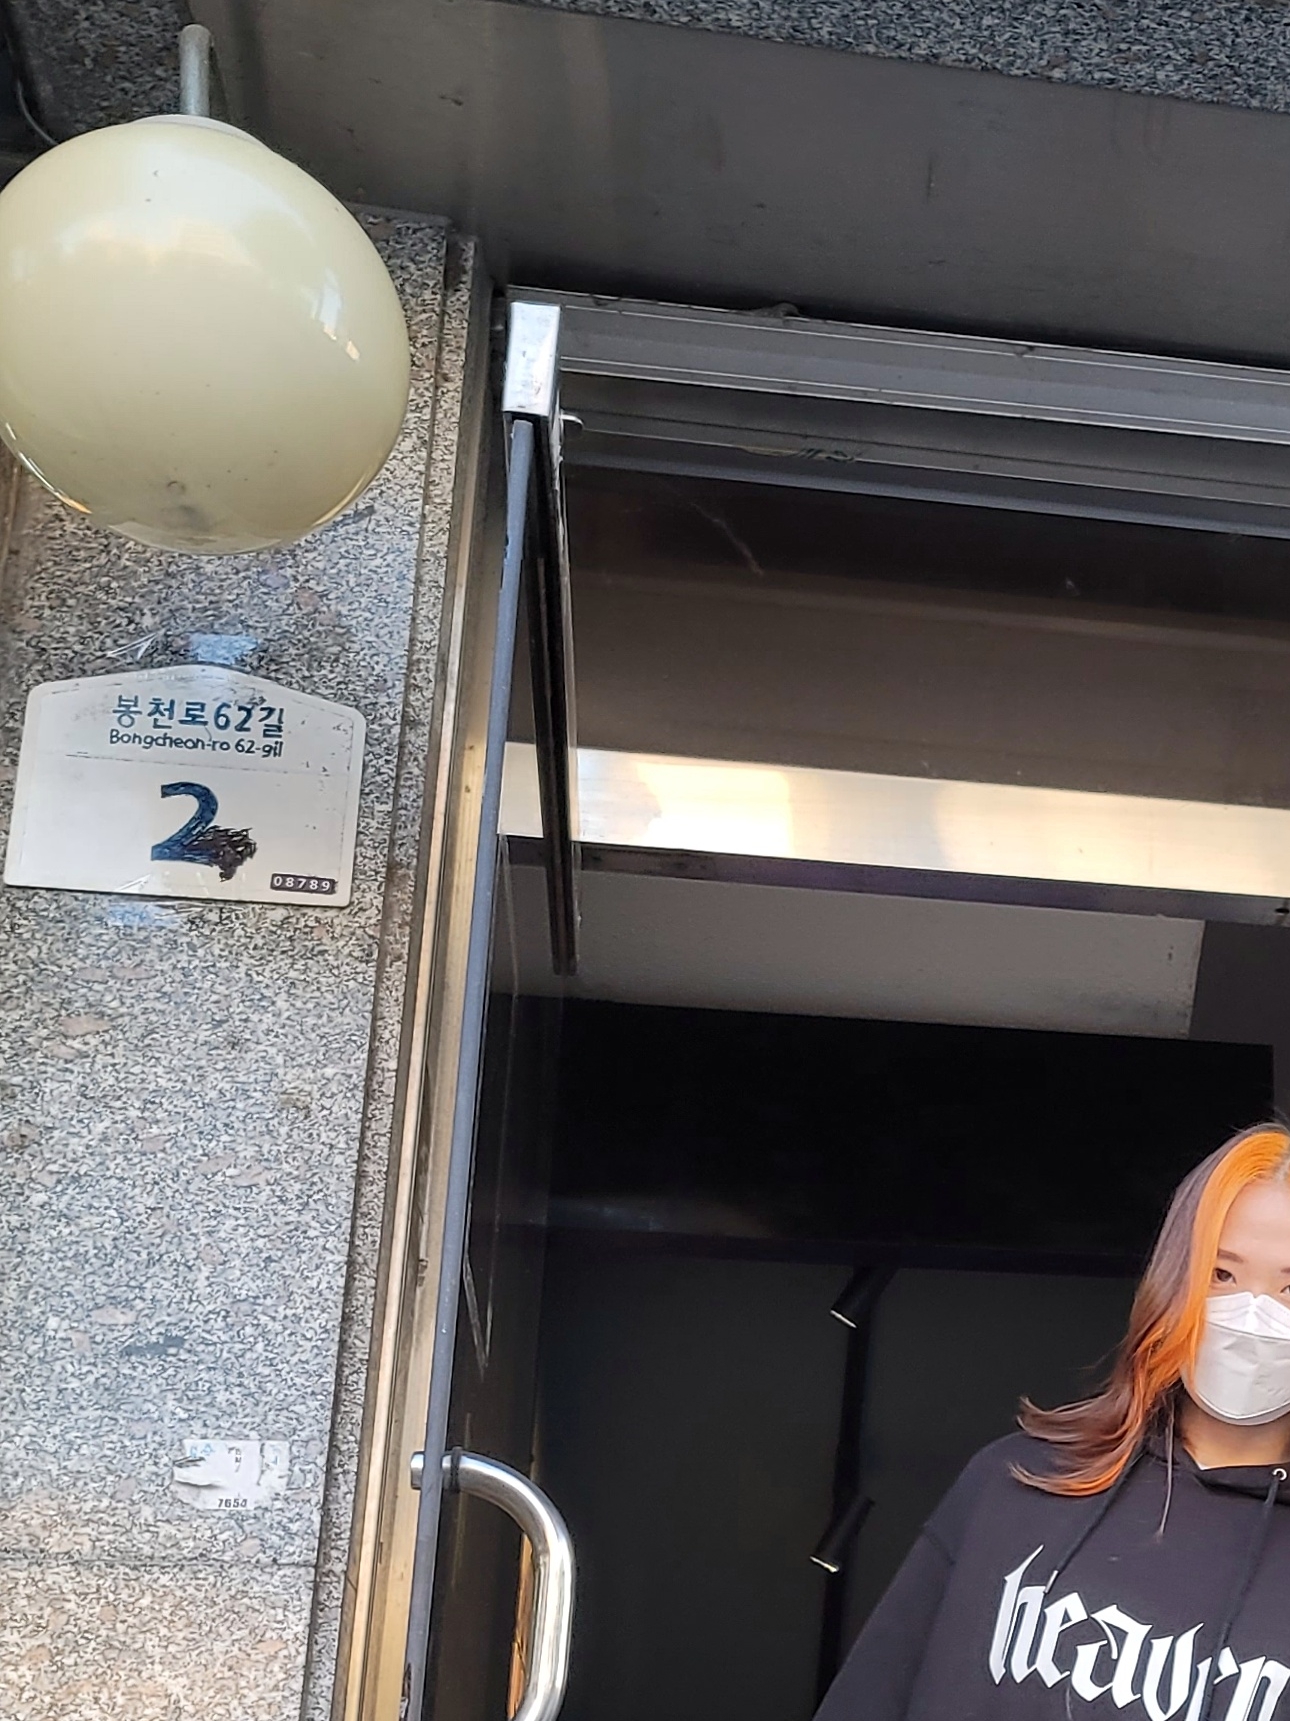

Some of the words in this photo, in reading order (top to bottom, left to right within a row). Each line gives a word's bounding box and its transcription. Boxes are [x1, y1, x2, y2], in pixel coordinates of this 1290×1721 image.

[112, 695, 284, 739] 봉천로62길
[109, 728, 231, 751] Bongcheon-ro
[234, 738, 284, 759] 62-gil
[151, 781, 224, 868] 2
[273, 876, 331, 892] 08789
